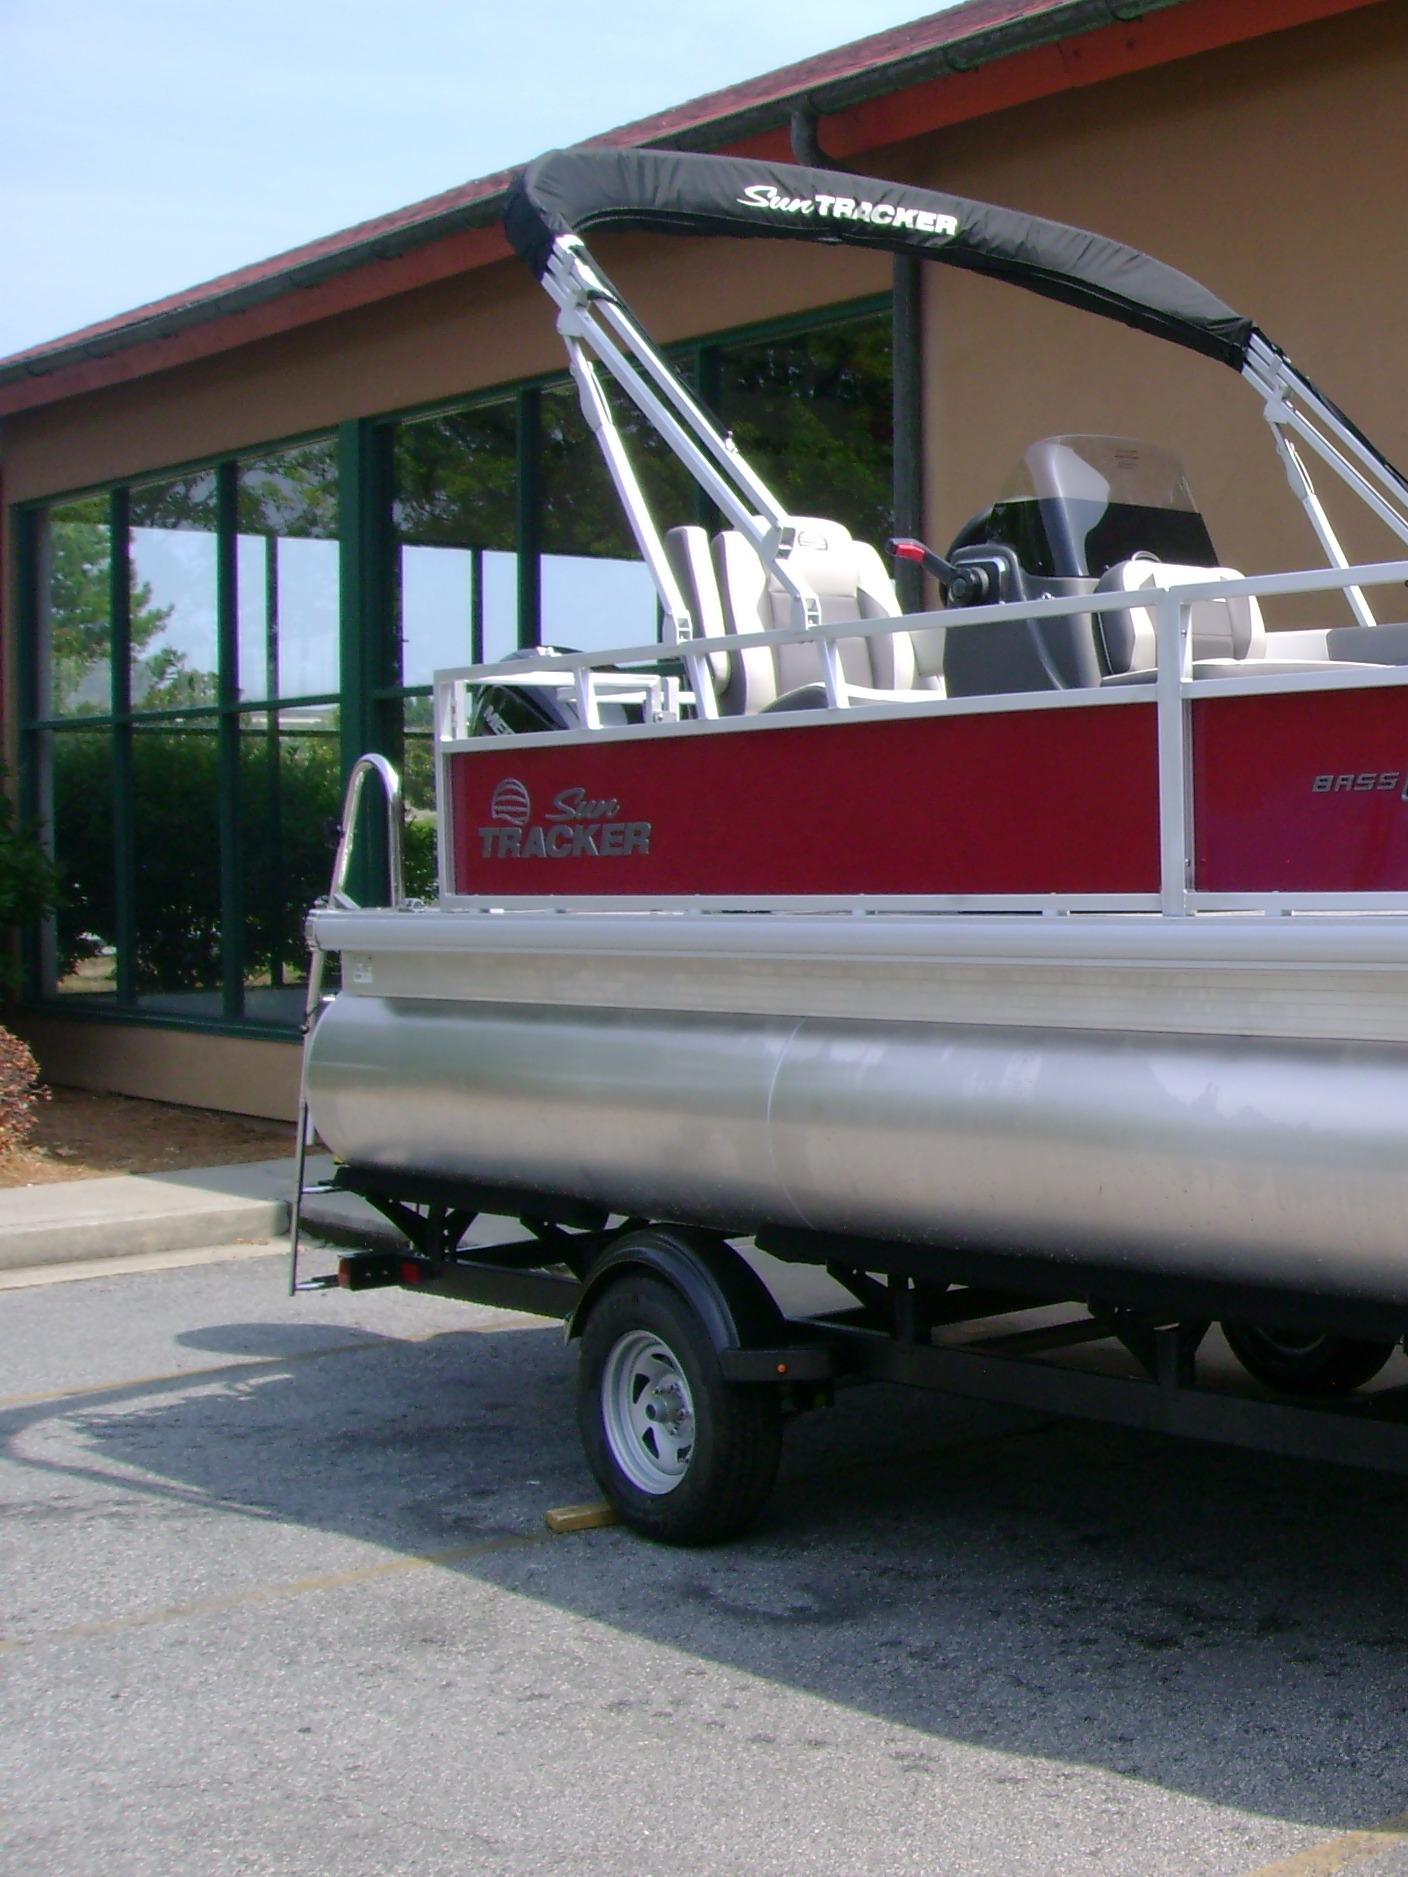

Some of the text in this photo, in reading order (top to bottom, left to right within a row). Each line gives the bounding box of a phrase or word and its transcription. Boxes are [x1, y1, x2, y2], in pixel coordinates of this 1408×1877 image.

[736, 185, 958, 235] Sun TRACKER
[1313, 772, 1399, 792] BASS
[545, 787, 620, 820] Sun
[479, 821, 651, 858] TRACKER
